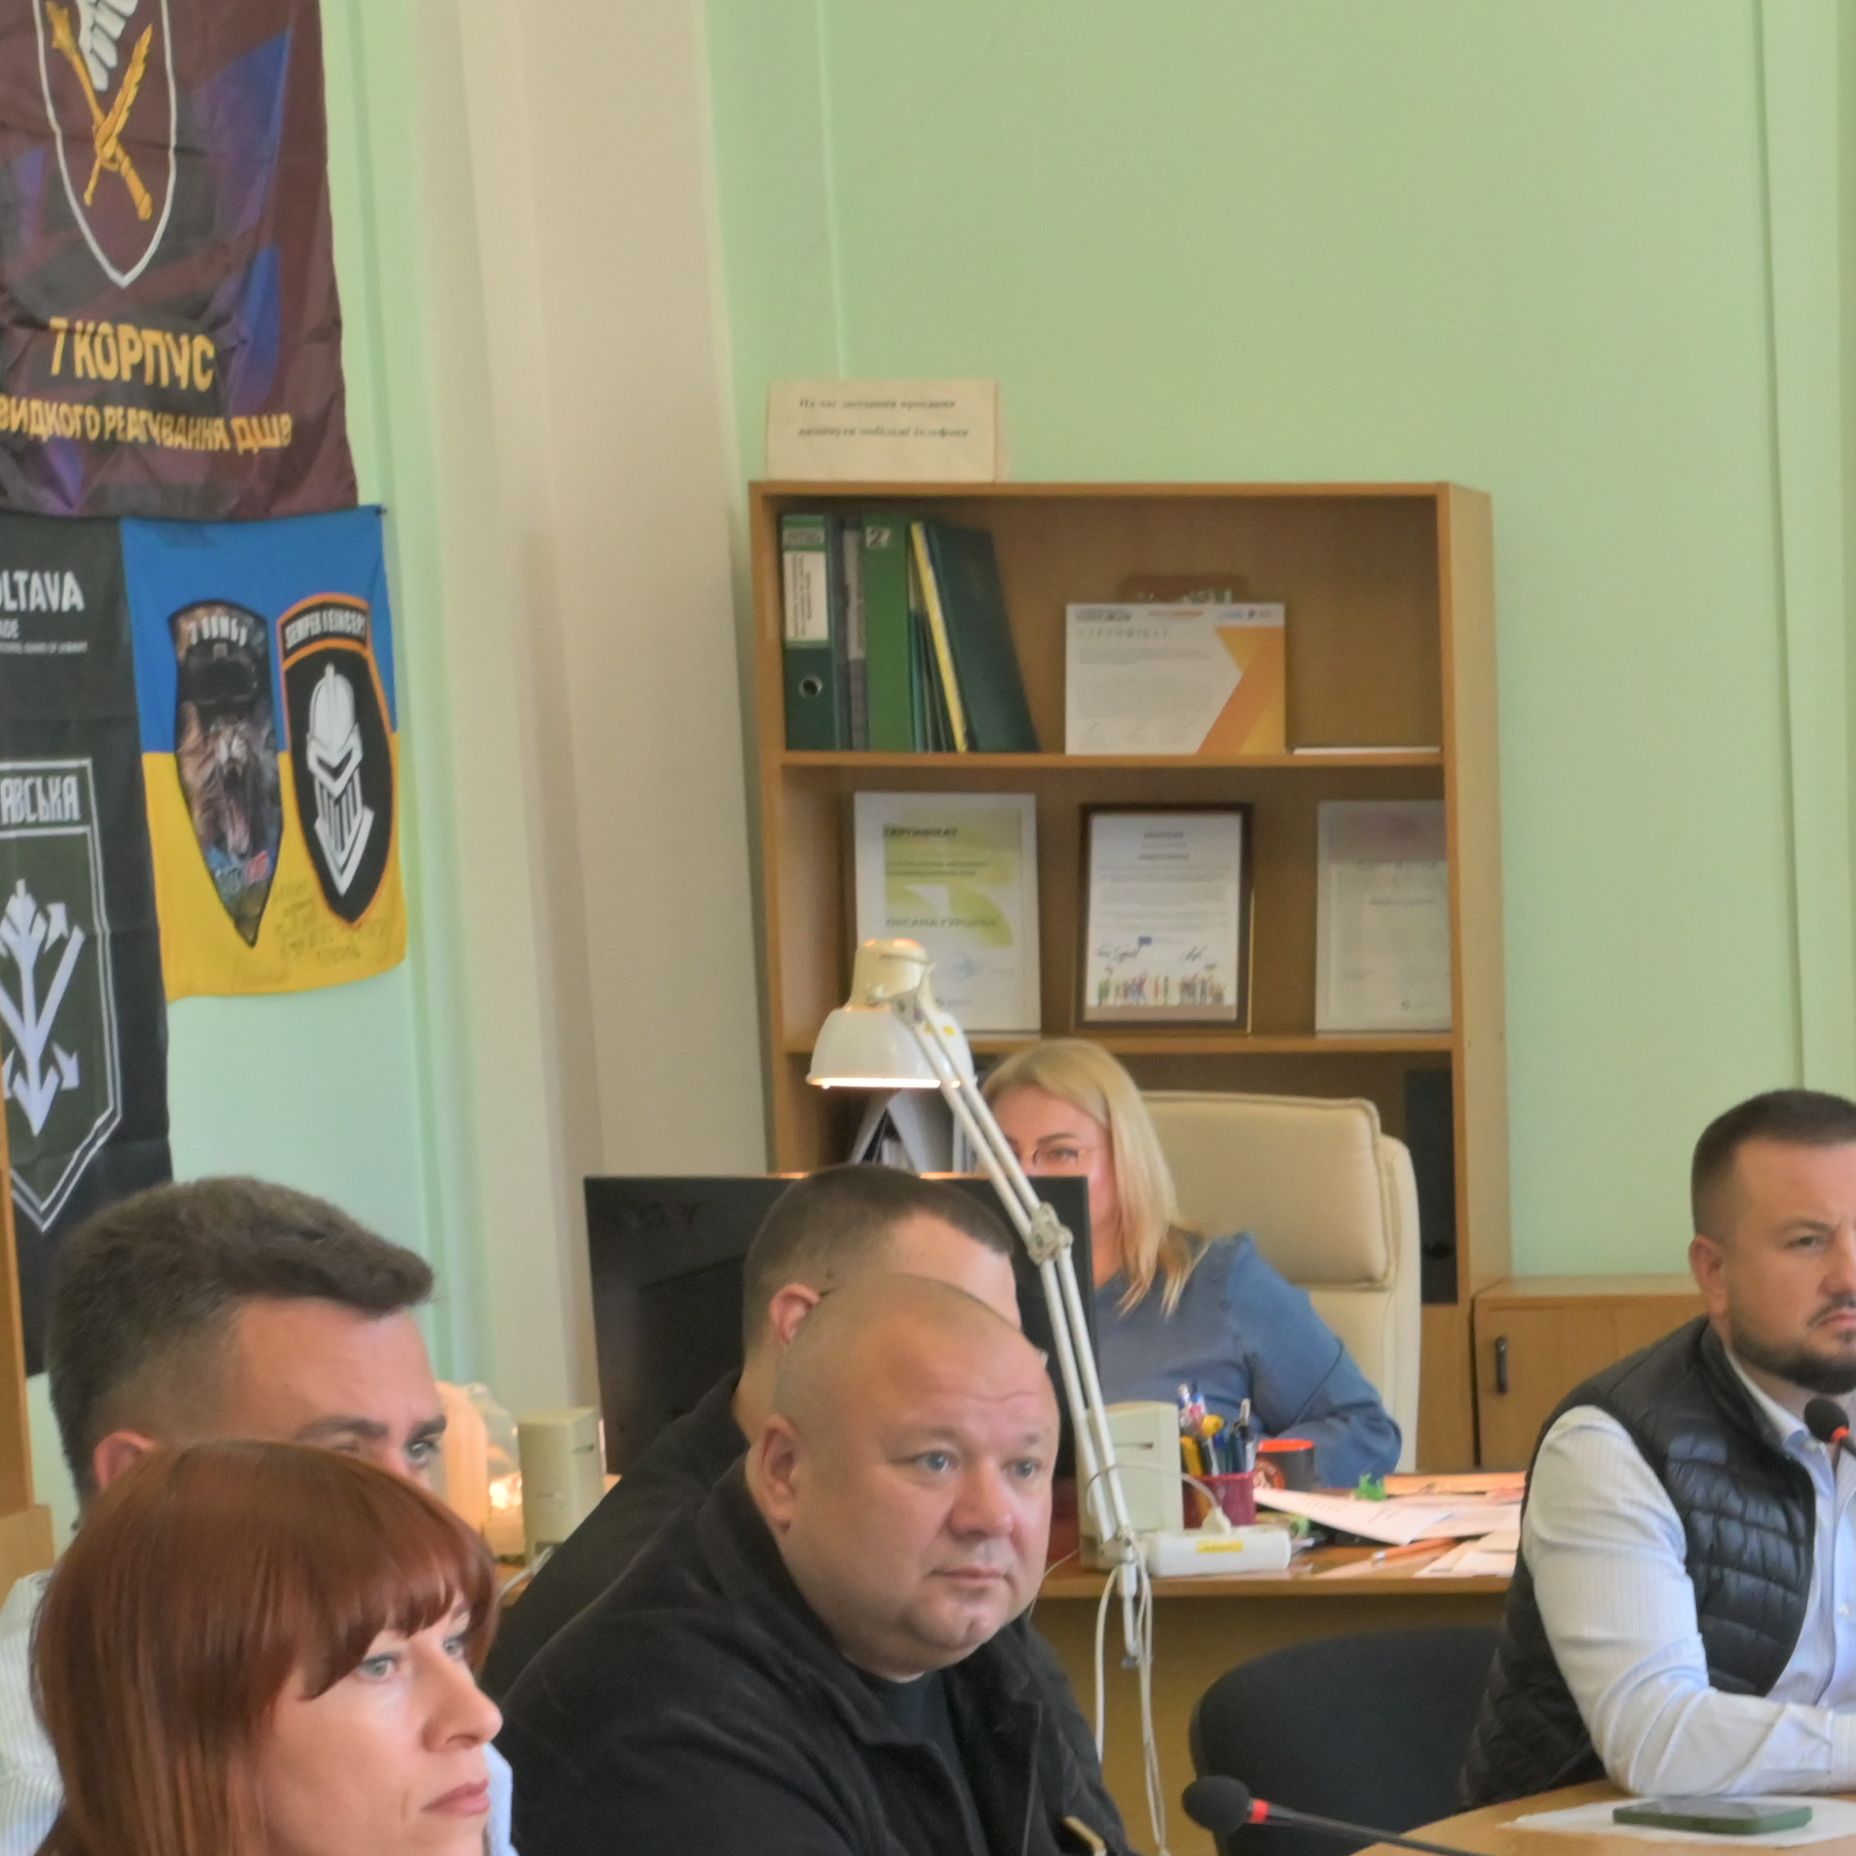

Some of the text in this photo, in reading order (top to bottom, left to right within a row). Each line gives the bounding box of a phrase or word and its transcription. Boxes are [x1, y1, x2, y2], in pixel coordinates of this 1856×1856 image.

[50, 317, 215, 392] 7 КОРПУС
[103, 406, 230, 450] РЕАГУВАННЯ
[0, 570, 85, 613] LTAVA
